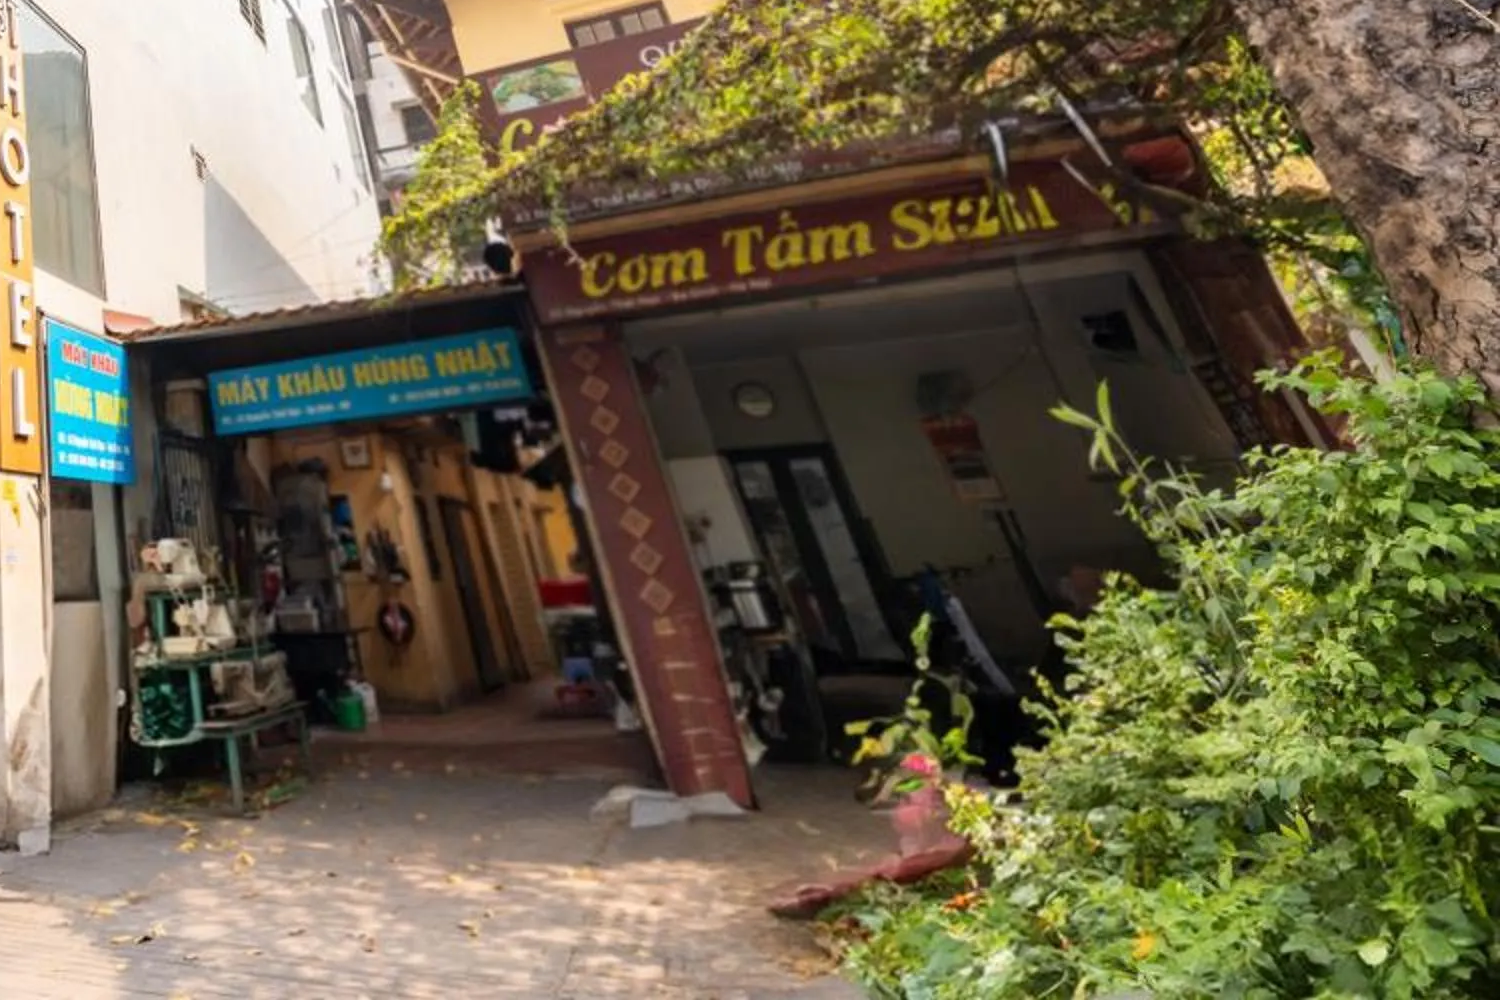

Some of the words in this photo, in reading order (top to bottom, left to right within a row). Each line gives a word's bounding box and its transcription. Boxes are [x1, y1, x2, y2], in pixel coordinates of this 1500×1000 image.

[216, 373, 270, 407] MÁY
[278, 363, 347, 399] KHÂU
[352, 354, 430, 388] HÙNG
[434, 340, 512, 377] NHẬT
